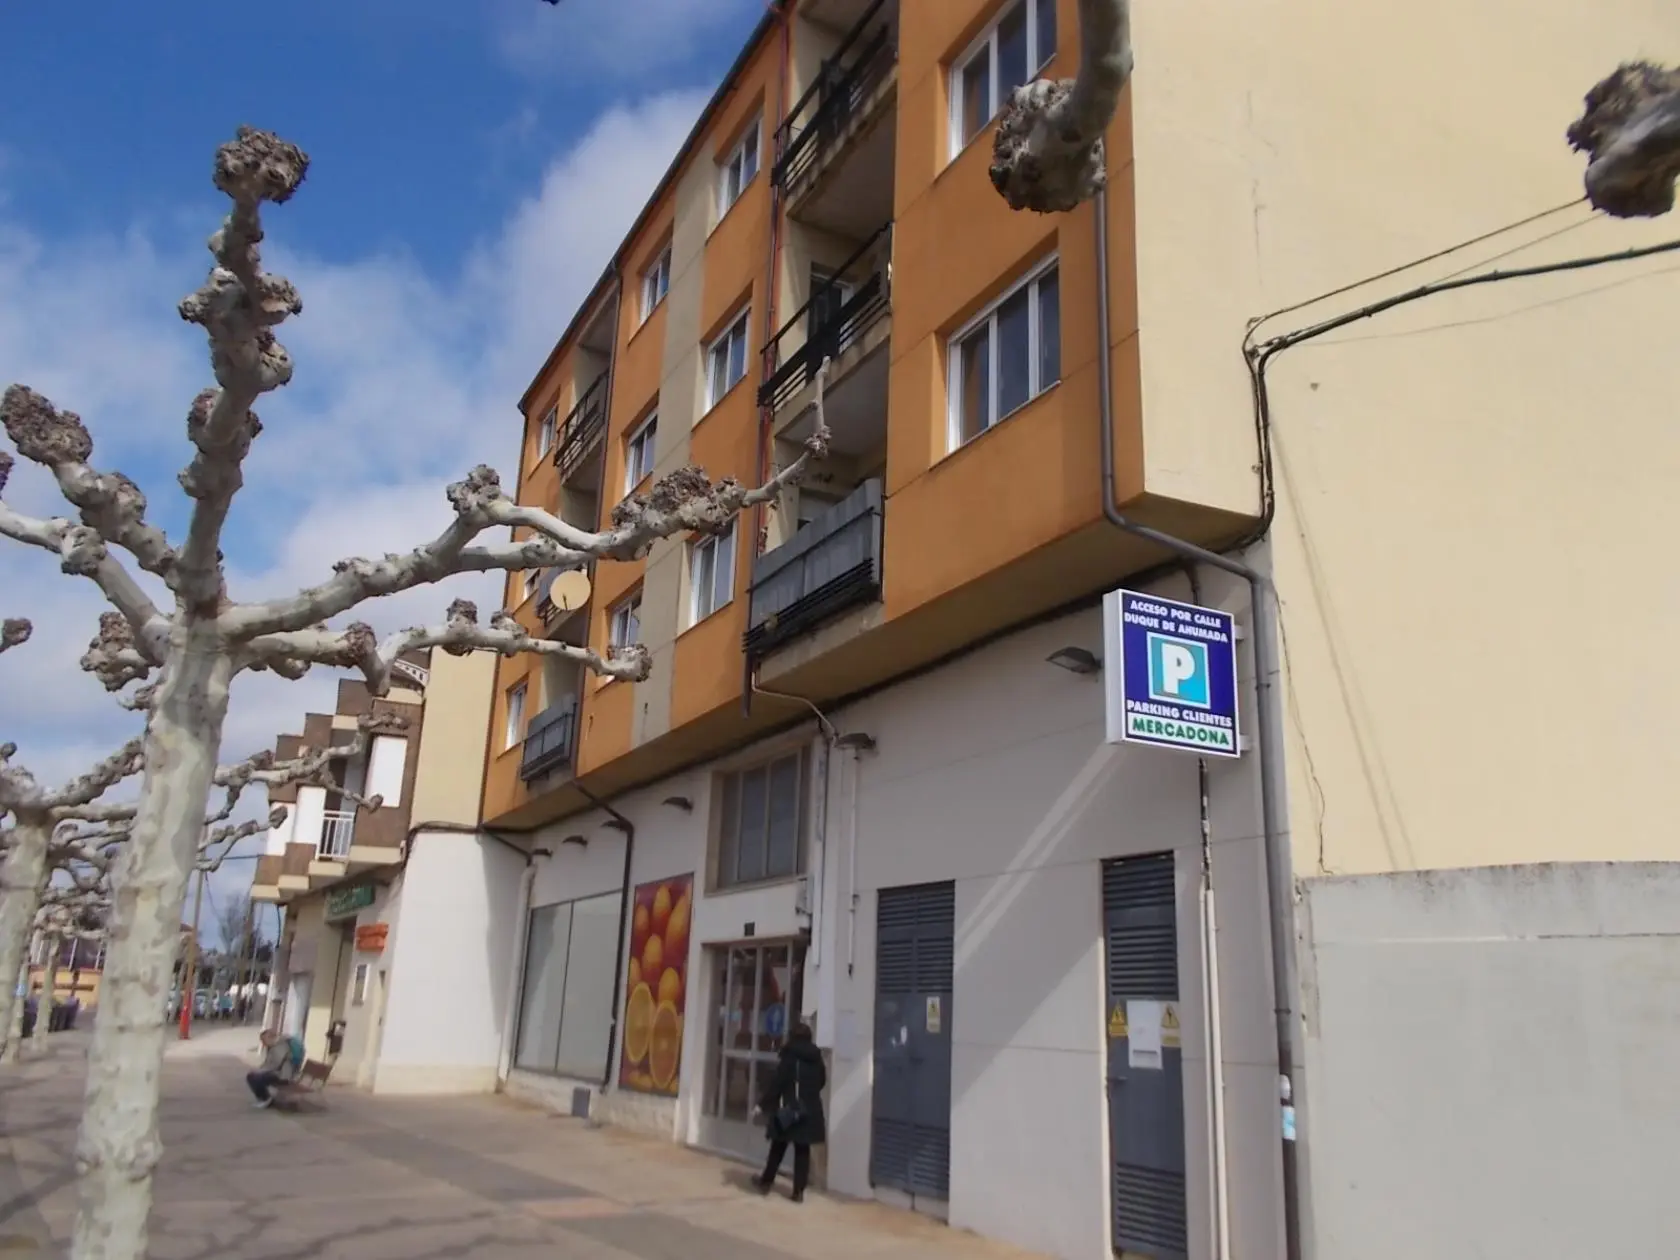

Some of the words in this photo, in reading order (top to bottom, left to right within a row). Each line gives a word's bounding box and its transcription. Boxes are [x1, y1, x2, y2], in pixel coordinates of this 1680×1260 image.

[1124, 613, 1159, 628] DUQUE
[1162, 621, 1176, 632] DE
[1178, 624, 1228, 643] AHUMADA
[1130, 600, 1168, 617] ACCESO
[1171, 609, 1191, 622] POR
[1194, 613, 1221, 628] CALLE
[1161, 642, 1195, 694] P
[1127, 699, 1180, 719] PARKING
[1183, 709, 1232, 727] CLIENTES
[1132, 717, 1229, 745] MERCADONA
